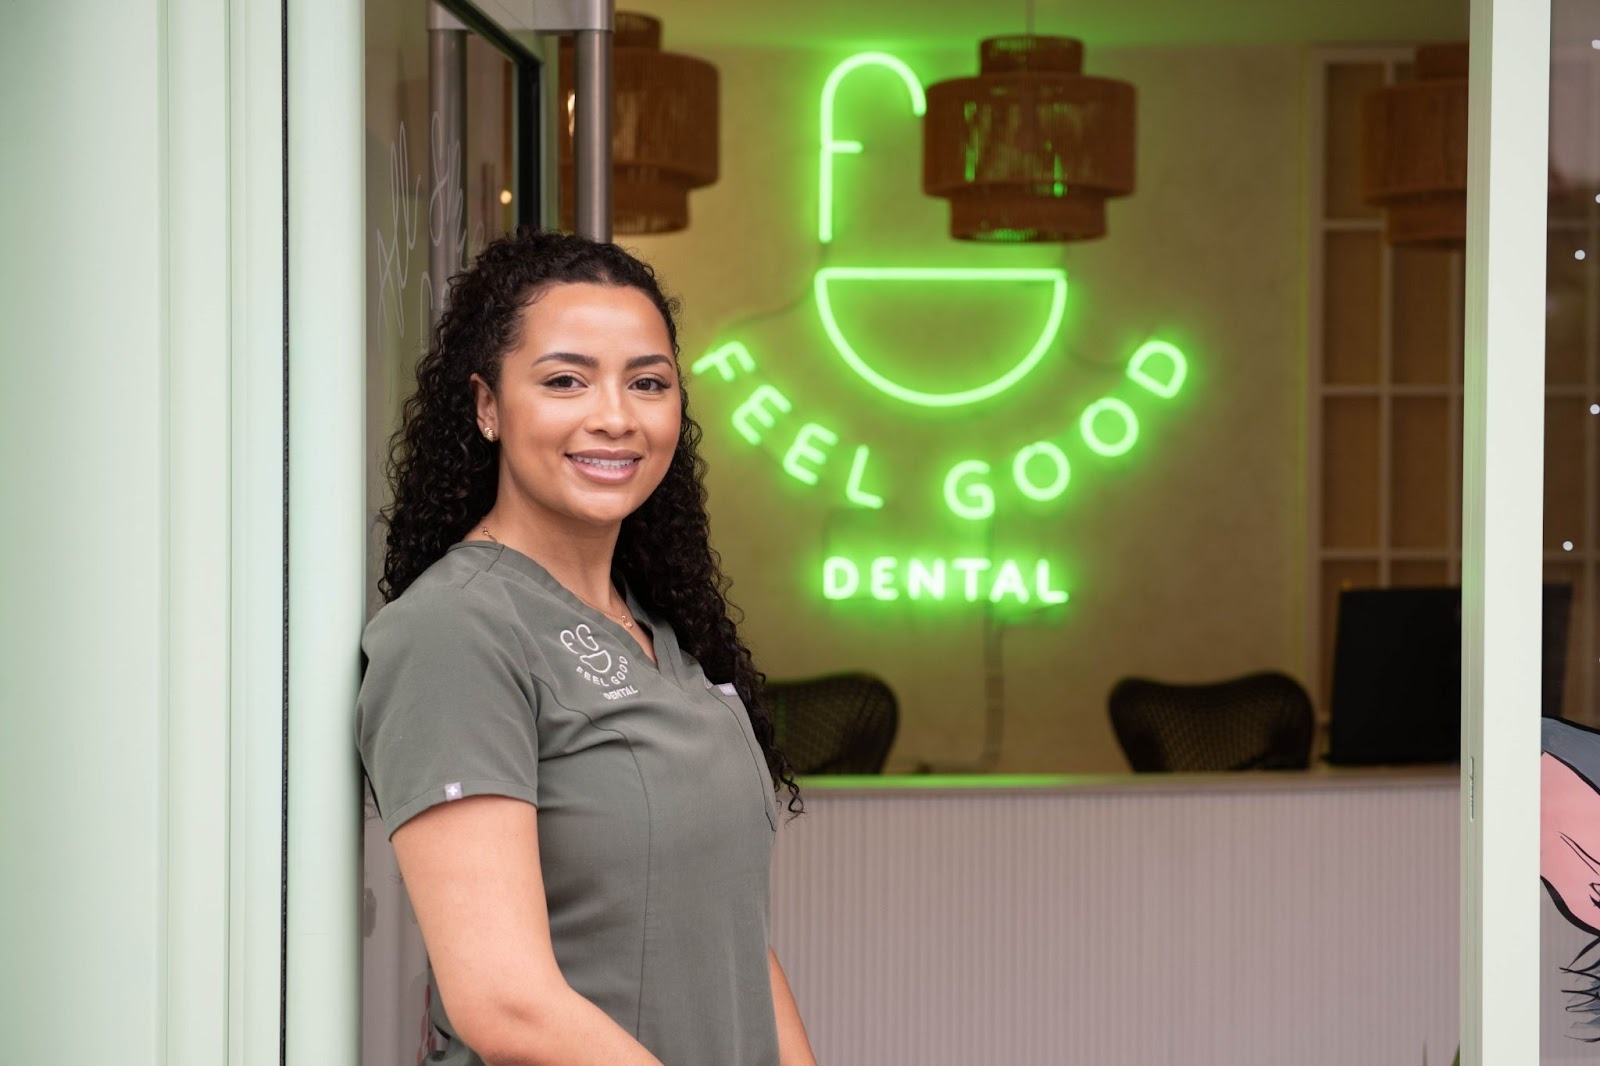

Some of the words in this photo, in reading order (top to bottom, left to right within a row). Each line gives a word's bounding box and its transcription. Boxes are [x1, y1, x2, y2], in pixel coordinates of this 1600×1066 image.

[691, 340, 884, 509] FEEL
[943, 340, 1189, 519] GOOD
[822, 556, 1069, 603] DENTAL
[576, 665, 609, 687] FEEL
[610, 655, 629, 685] GOOD
[603, 685, 639, 700] DENTAL
